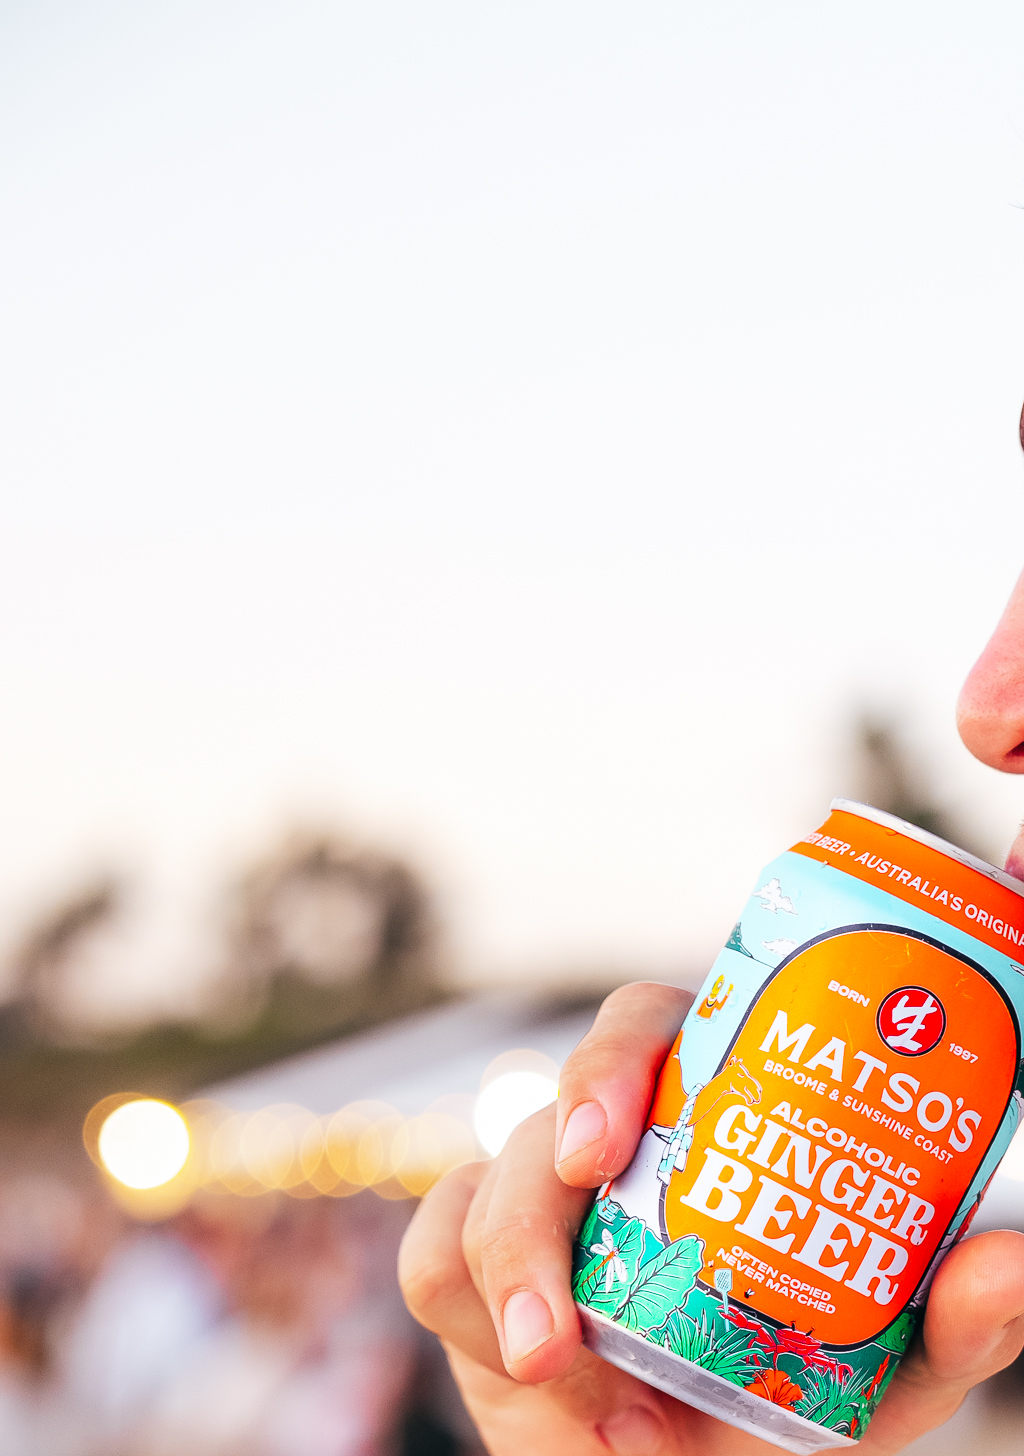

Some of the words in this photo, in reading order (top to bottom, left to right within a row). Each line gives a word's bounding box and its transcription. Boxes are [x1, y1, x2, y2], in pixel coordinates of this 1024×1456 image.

[815, 835, 851, 856] BEER
[854, 851, 964, 911] AUSTRALIA'S
[827, 979, 871, 1008] BORN
[758, 1009, 983, 1153] MATSO'S
[949, 1042, 979, 1064] 1997
[763, 1059, 828, 1096] BROOME
[828, 1089, 840, 1102] &
[842, 1094, 914, 1141] SUNSHINE
[914, 1131, 954, 1165] COAST
[770, 1100, 921, 1187] ALCOHOLIC
[713, 1104, 936, 1246] GINGER
[679, 1147, 909, 1306] BEER
[716, 1247, 766, 1284] NEVER
[765, 1278, 836, 1315] MATCHED
[731, 1245, 779, 1278] OFTEN
[779, 1272, 832, 1302] COPIED
